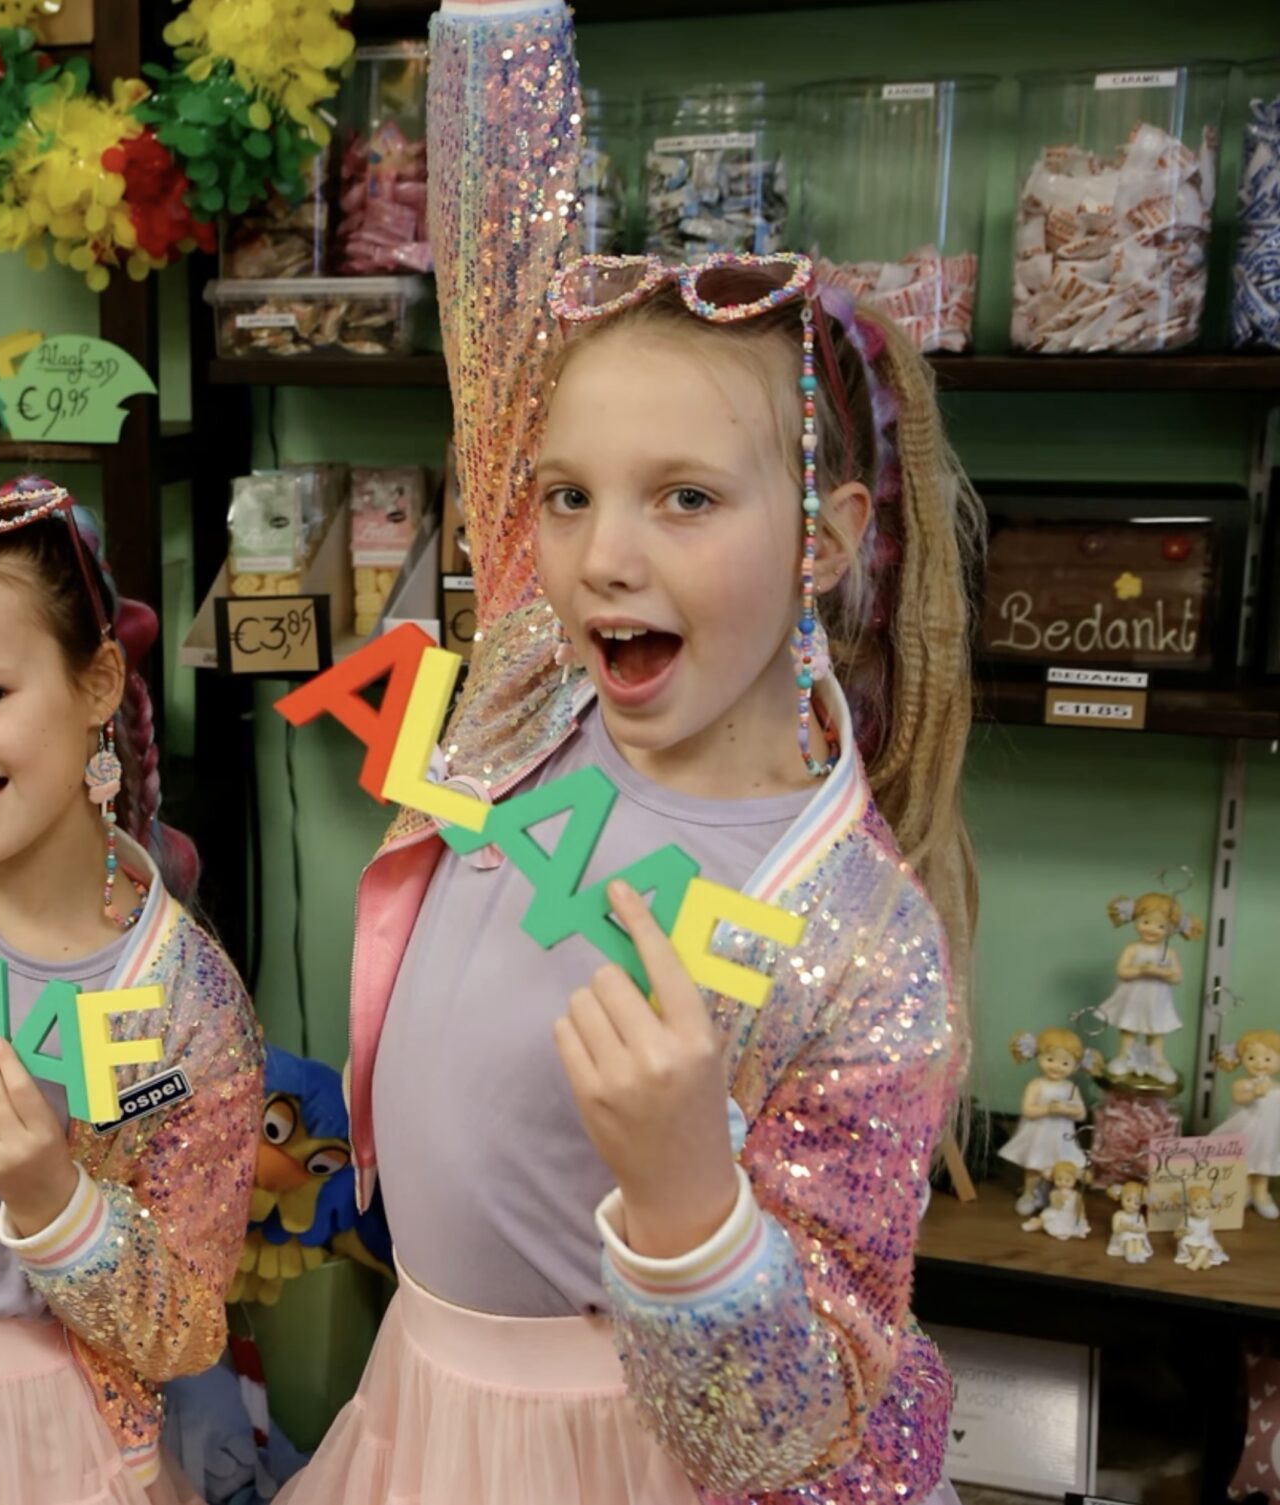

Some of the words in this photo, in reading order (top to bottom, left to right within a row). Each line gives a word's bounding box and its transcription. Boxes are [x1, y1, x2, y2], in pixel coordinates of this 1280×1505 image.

[38, 341, 91, 384] Alaaf
[87, 357, 119, 389] 3D
[230, 603, 314, 660] €3,85
[990, 590, 1198, 655] Bedankt
[1050, 670, 1145, 684] BEDANKT
[120, 1076, 183, 1114] ospel
